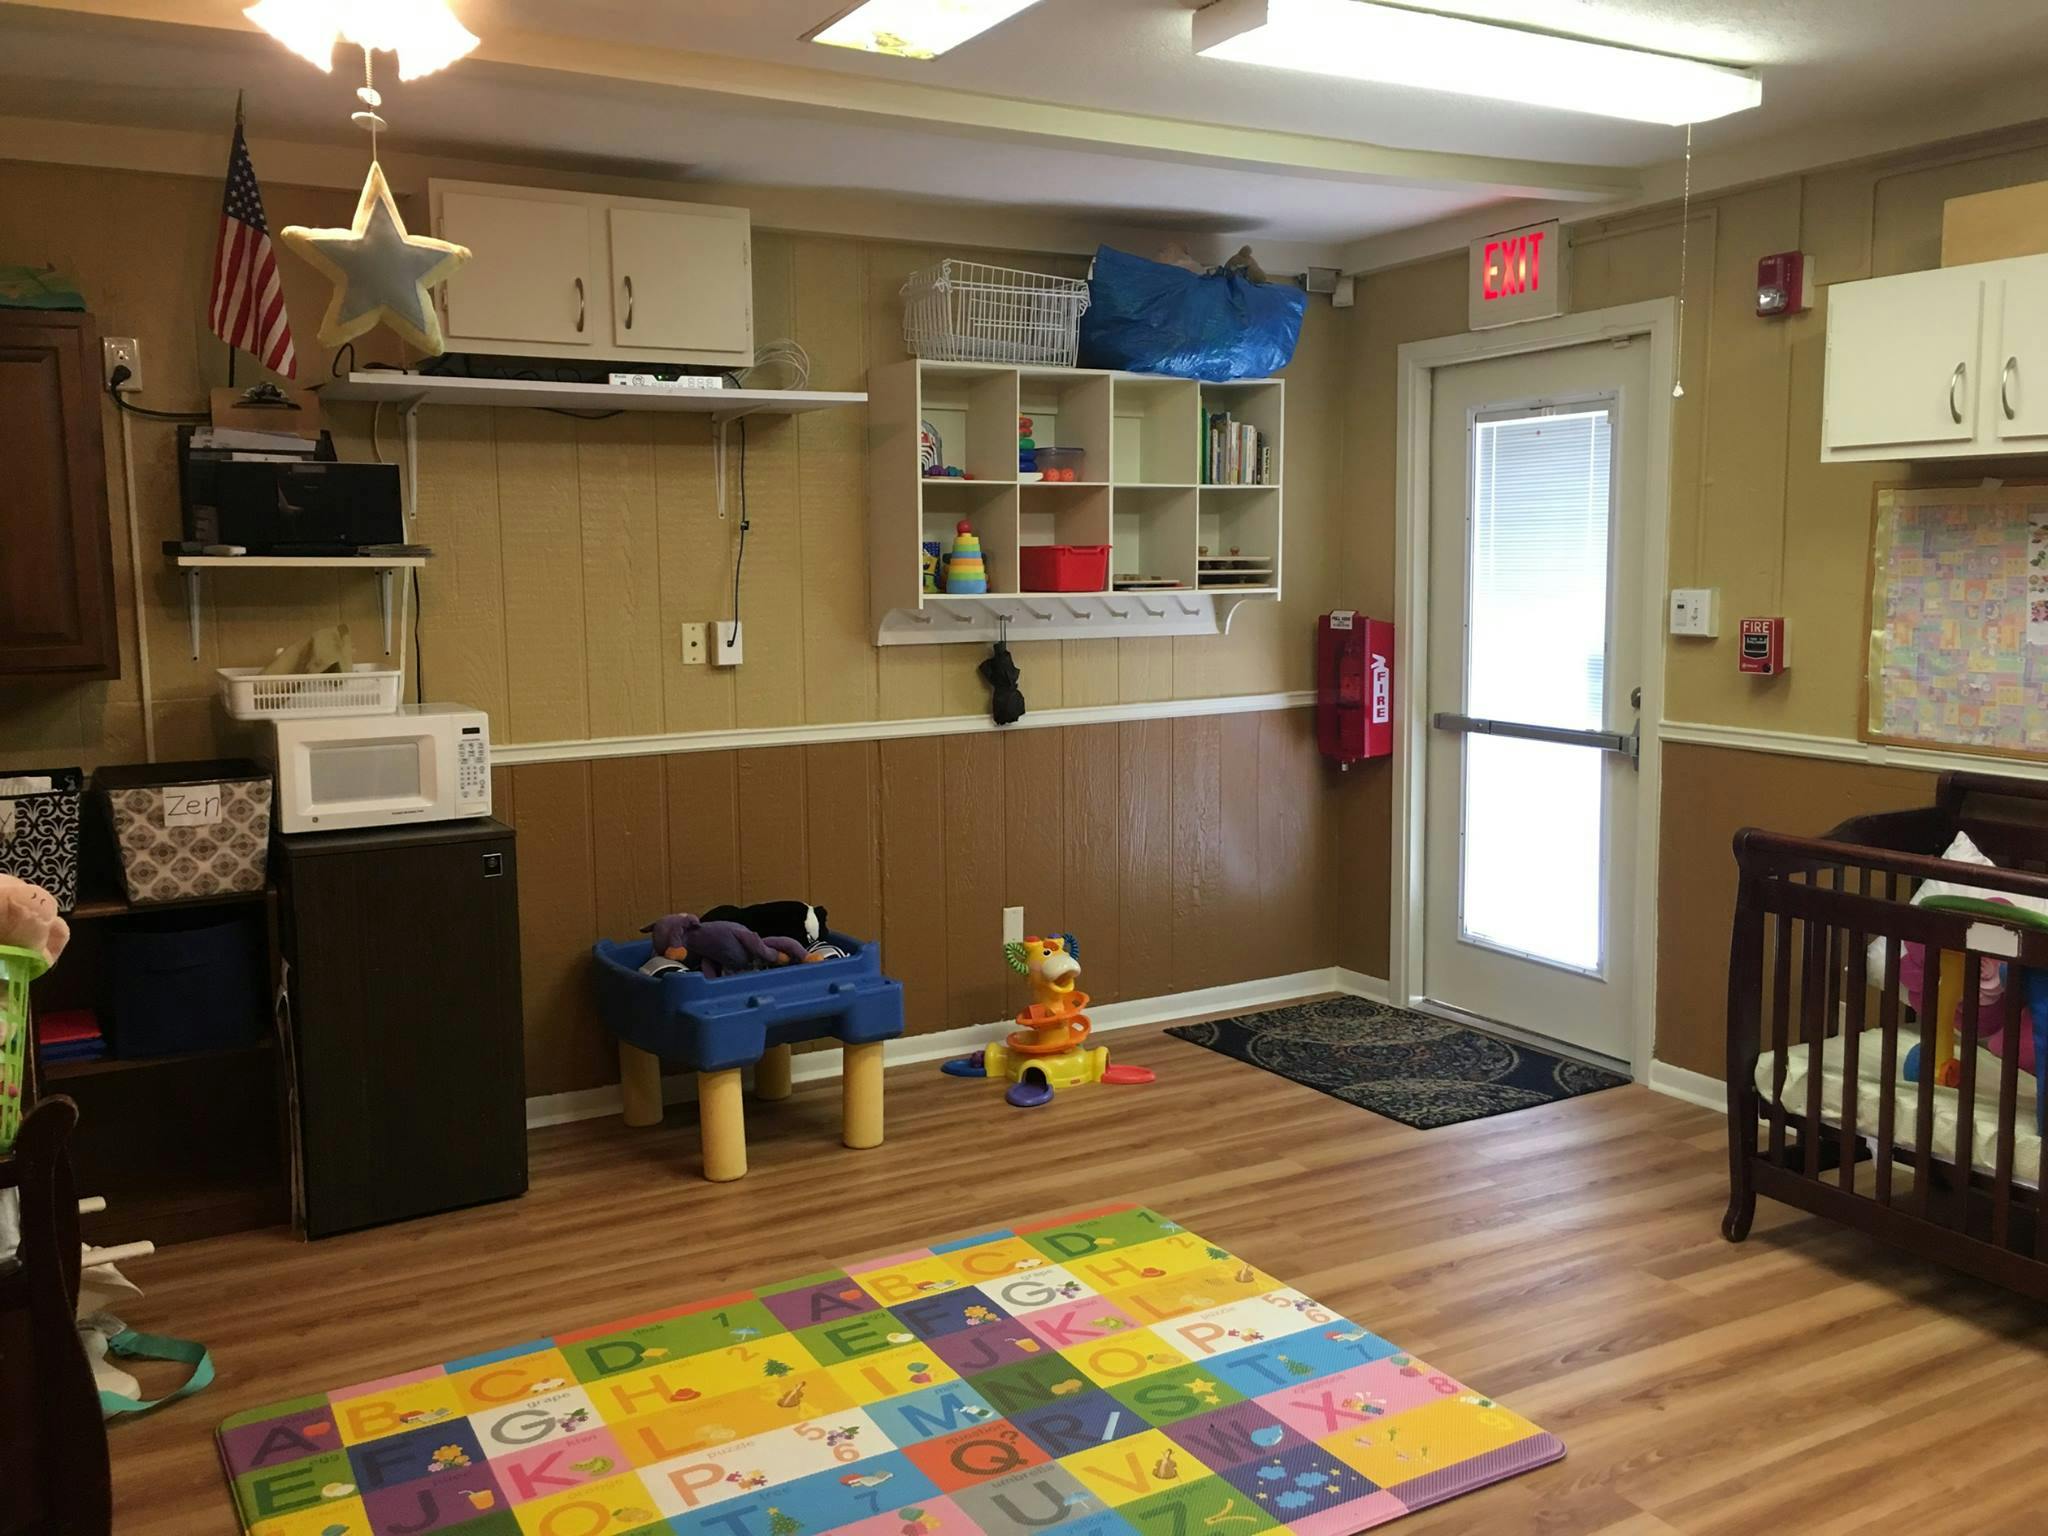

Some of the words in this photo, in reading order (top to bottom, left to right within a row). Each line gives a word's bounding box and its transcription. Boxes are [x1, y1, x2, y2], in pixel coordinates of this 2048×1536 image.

[1483, 232, 1544, 300] EXIT
[1743, 621, 1770, 633] FIRE
[1376, 671, 1386, 718] FIRE
[165, 795, 221, 817] Zen
[1043, 1232, 1098, 1257] D
[962, 1252, 1017, 1275] C
[1085, 1257, 1142, 1286] H
[868, 1274, 921, 1302] B
[1001, 1281, 1056, 1306] G
[1262, 1294, 1290, 1308] 5
[712, 1312, 729, 1328] 1
[810, 1291, 863, 1322] A
[903, 1302, 951, 1336] F
[1130, 1295, 1194, 1320] L
[1305, 1308, 1330, 1324] 6
[824, 1322, 889, 1356] E
[1034, 1311, 1105, 1345] K
[1176, 1322, 1225, 1354] P
[585, 1341, 648, 1375] D
[960, 1337, 999, 1369] J
[1089, 1347, 1148, 1378] O
[1345, 1343, 1374, 1361] 7
[469, 1369, 533, 1402] C
[1226, 1353, 1287, 1385] T
[1428, 1376, 1458, 1394] 8
[527, 1391, 571, 1409] grape
[610, 1374, 674, 1415] H
[982, 1371, 1056, 1412] N
[1134, 1384, 1199, 1417] S
[346, 1401, 401, 1440] B
[490, 1410, 556, 1445] G
[897, 1393, 980, 1437] M
[1288, 1391, 1372, 1433] X
[250, 1426, 321, 1466] A
[638, 1427, 707, 1459] L
[793, 1422, 826, 1440] 5
[1027, 1413, 1101, 1451] R
[1183, 1419, 1267, 1463] W
[361, 1440, 418, 1488] F
[833, 1442, 860, 1462] 6
[950, 1440, 1028, 1475] Q
[508, 1450, 584, 1500] K
[667, 1463, 725, 1507] P
[991, 1464, 1056, 1488] umbrella
[1082, 1452, 1151, 1494] V
[253, 1467, 322, 1517] E
[854, 1489, 879, 1512] 7
[990, 1480, 1071, 1526] U
[386, 1489, 440, 1534] J
[539, 1500, 610, 1536] O
[700, 1505, 758, 1536] T
